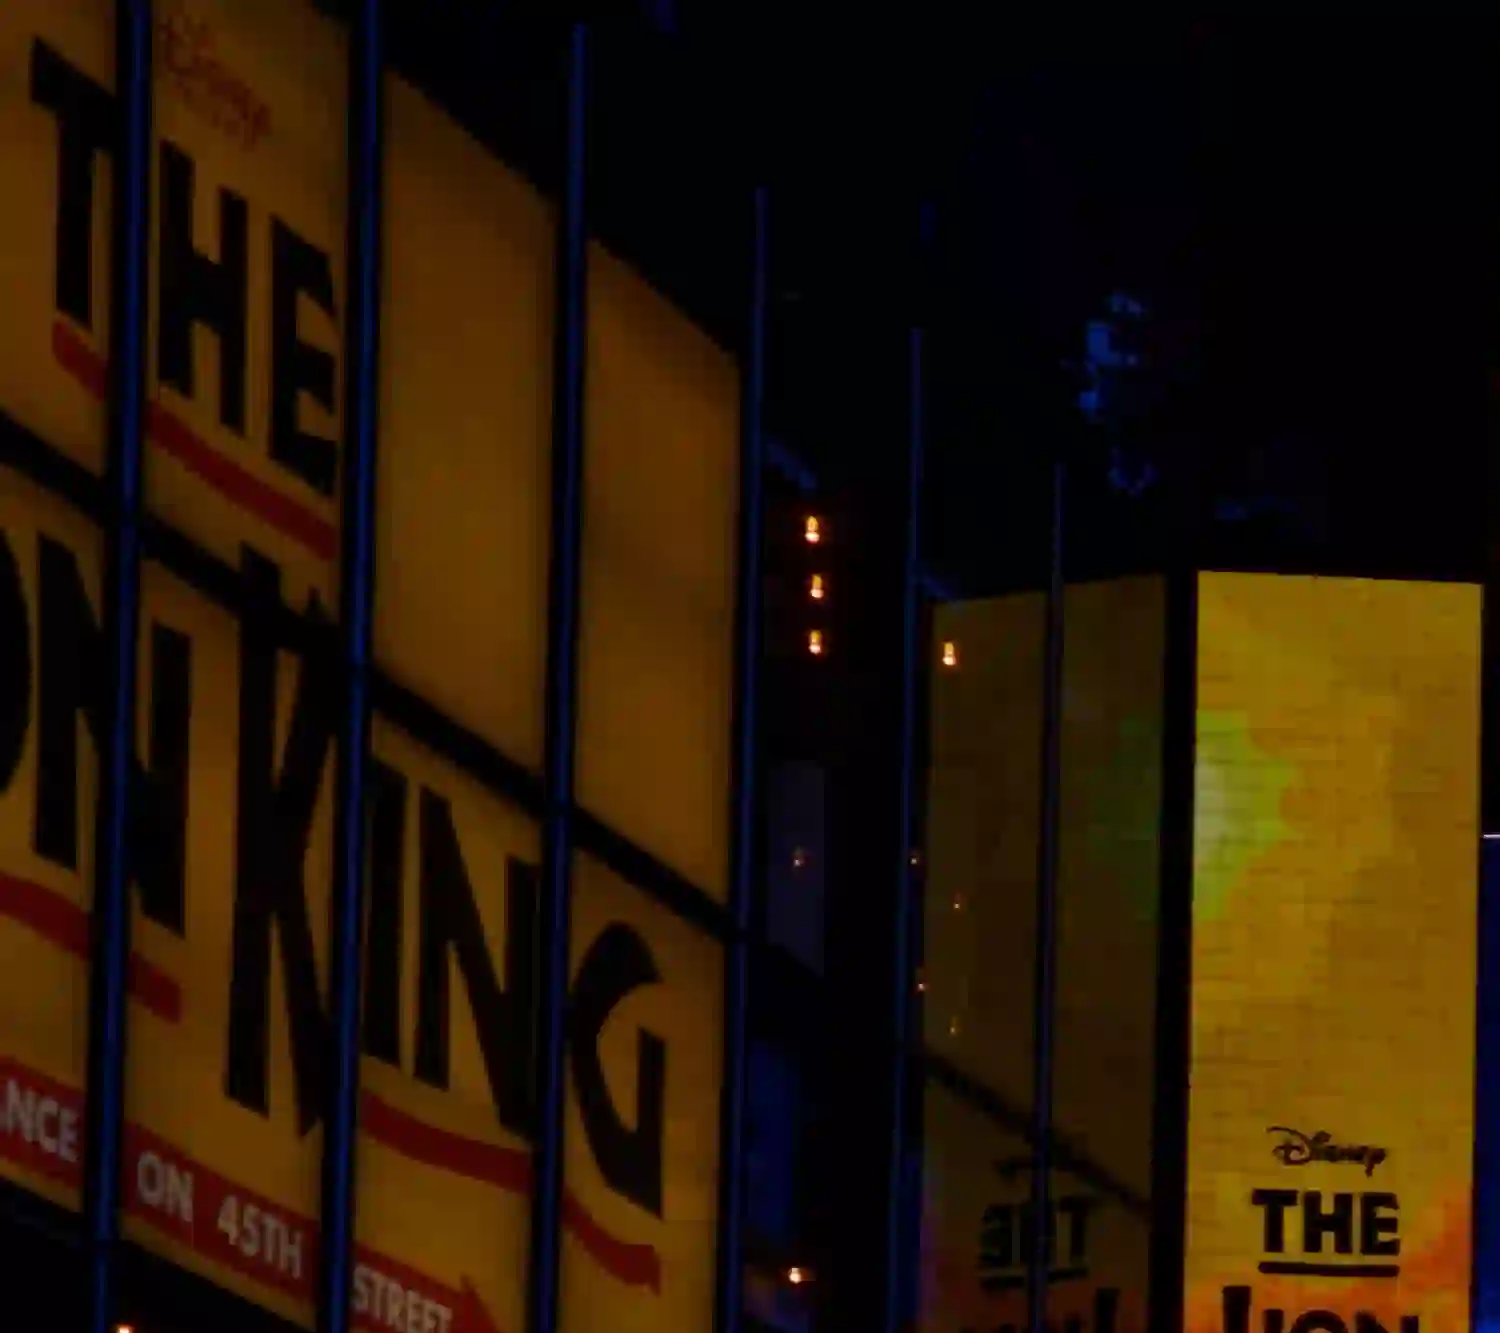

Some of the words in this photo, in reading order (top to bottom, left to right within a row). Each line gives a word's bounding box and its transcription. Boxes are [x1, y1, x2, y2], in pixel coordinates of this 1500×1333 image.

[32, 36, 337, 494] THE
[1266, 1125, 1387, 1177] Disney
[136, 1150, 196, 1226] ON
[216, 1193, 305, 1284] 45TH
[1251, 1189, 1401, 1256] THE
